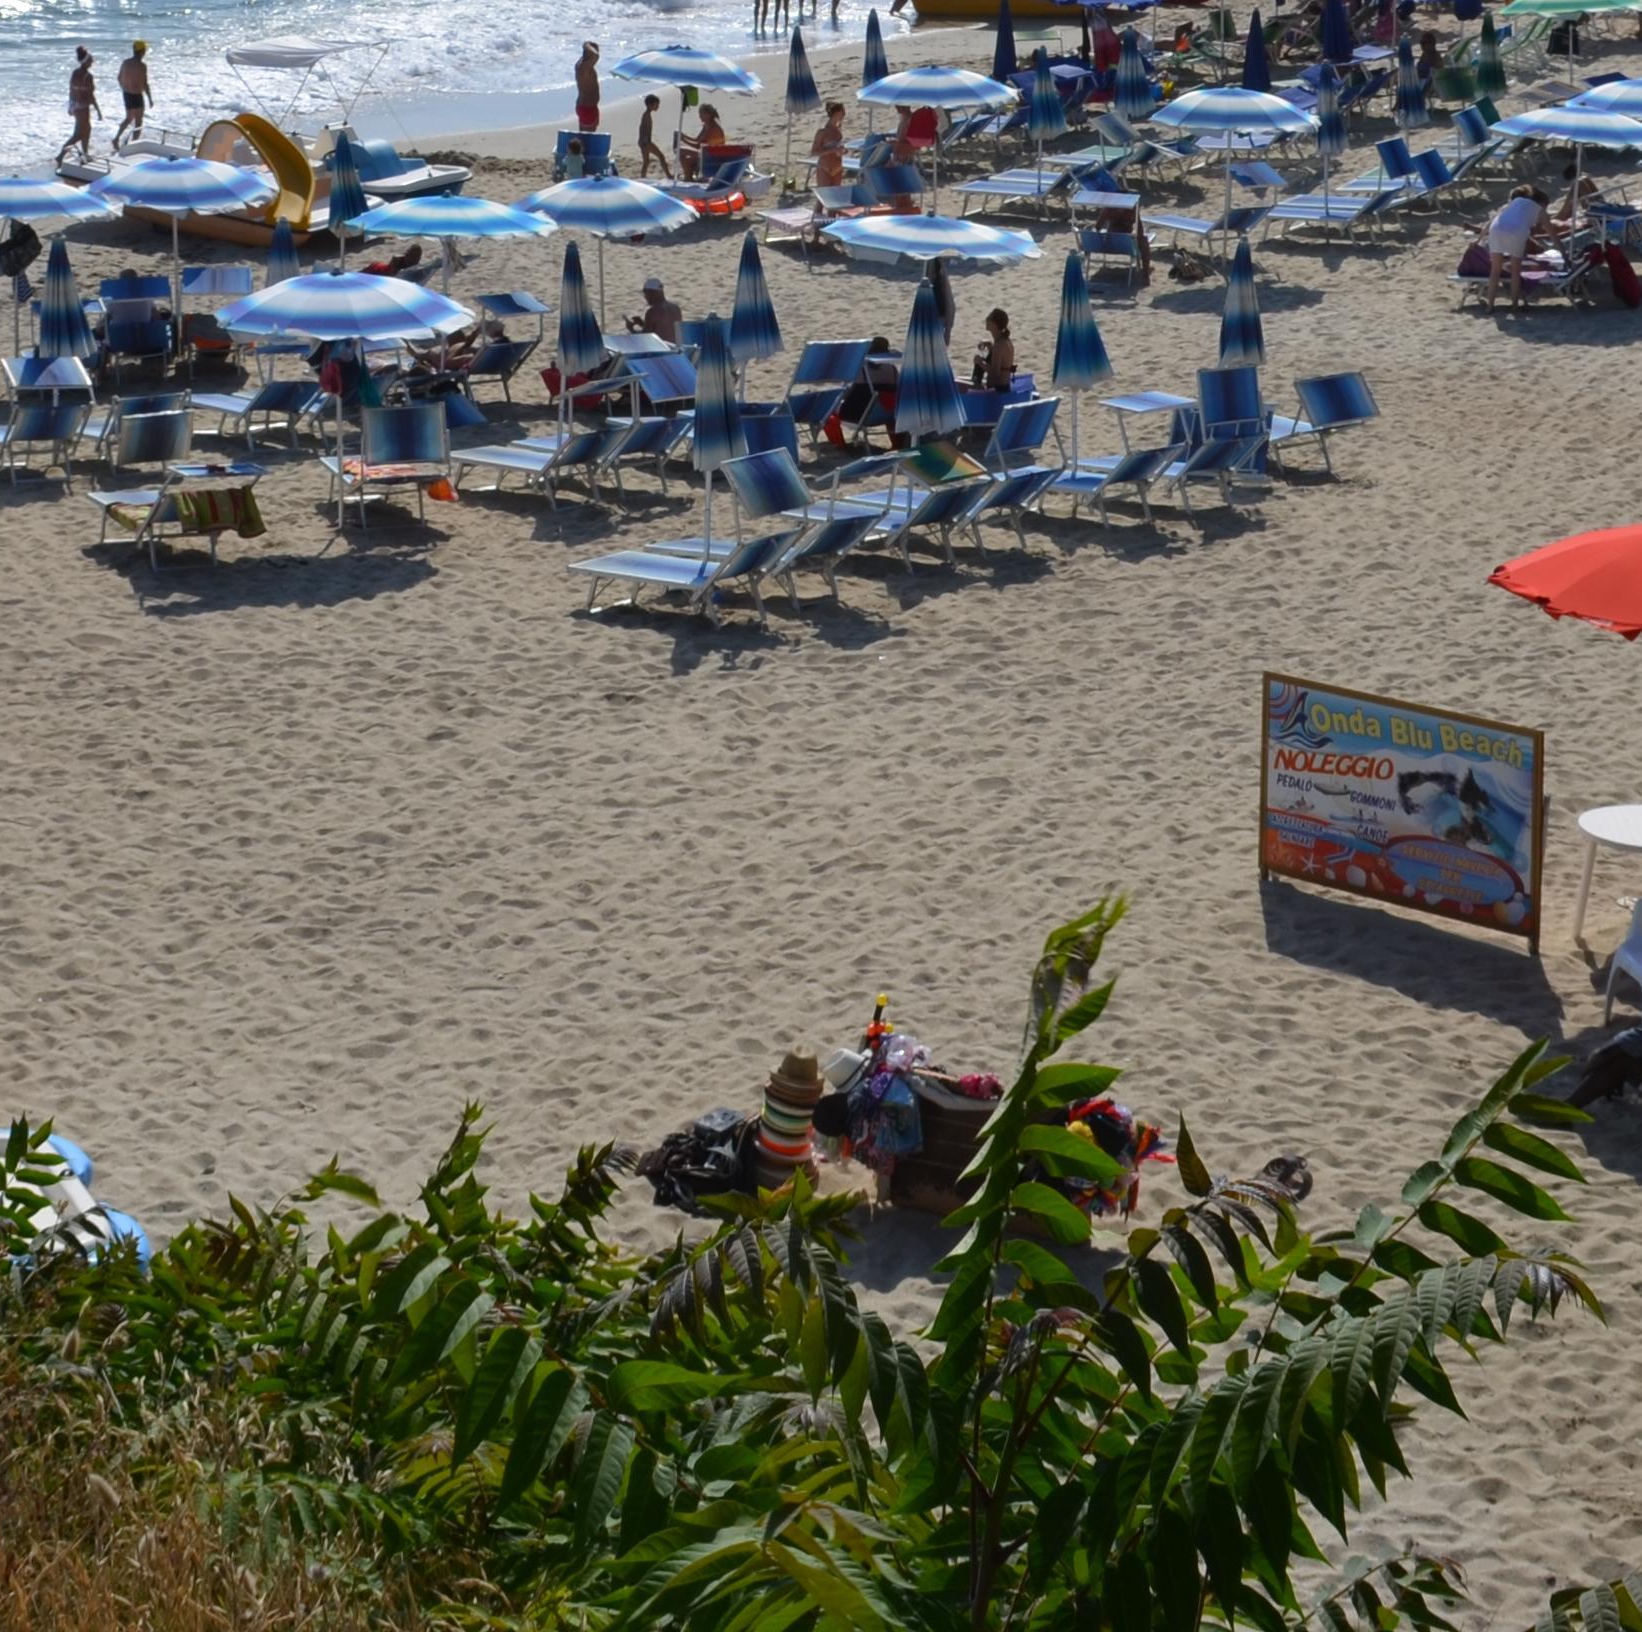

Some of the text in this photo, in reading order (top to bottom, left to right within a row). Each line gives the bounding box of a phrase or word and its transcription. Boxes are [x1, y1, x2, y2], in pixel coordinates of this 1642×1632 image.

[1310, 703, 1524, 768] Onda Blu Beach
[1274, 749, 1395, 780] NOLEGGIO
[1350, 790, 1397, 810] GOMMONI
[1357, 824, 1389, 844] CANOE
